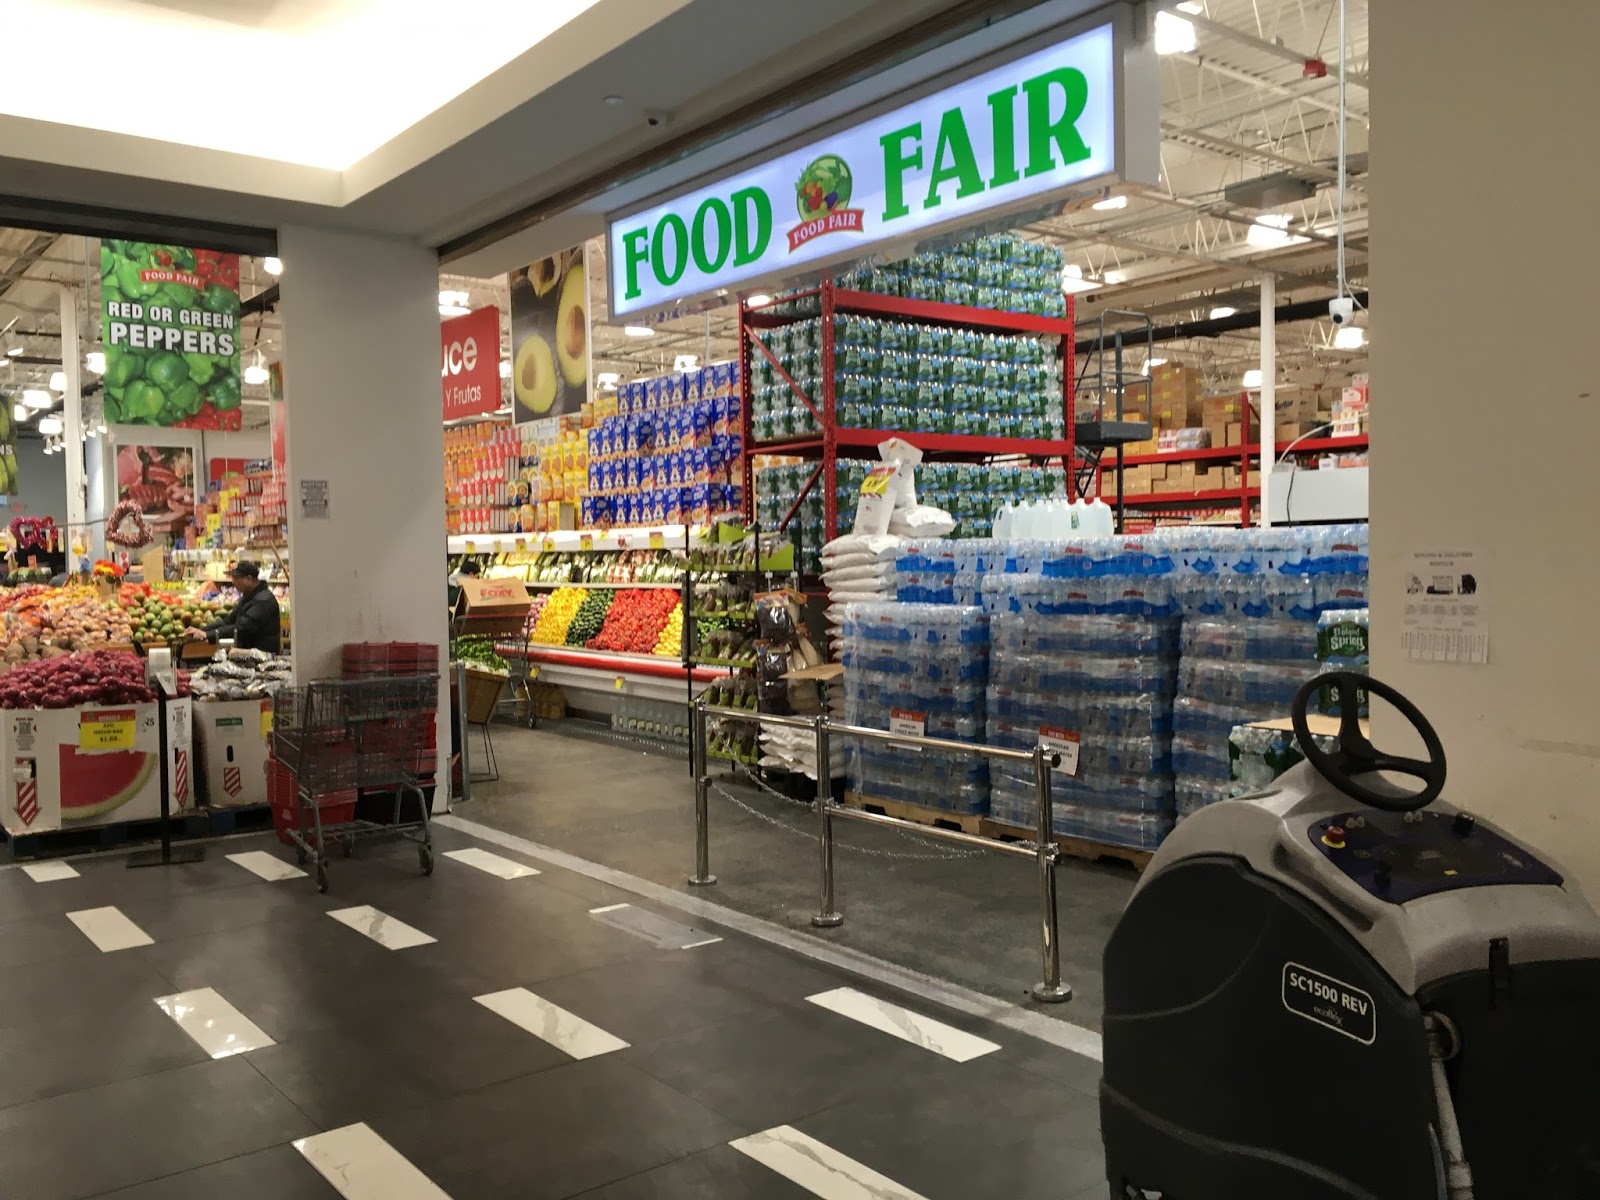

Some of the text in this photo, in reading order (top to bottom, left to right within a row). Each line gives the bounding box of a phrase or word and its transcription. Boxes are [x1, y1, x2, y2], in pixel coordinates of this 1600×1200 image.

[622, 66, 1092, 300] FOOD FAIR
[793, 212, 856, 245] FOOD FAIR
[144, 271, 200, 287] FOOD FAIR
[108, 301, 234, 330] RED OR GREEN
[110, 321, 234, 356] PEPPERS
[445, 383, 482, 408] Y Frutas
[1330, 634, 1366, 651] Spring
[1290, 972, 1368, 1016] SC1500 REV
